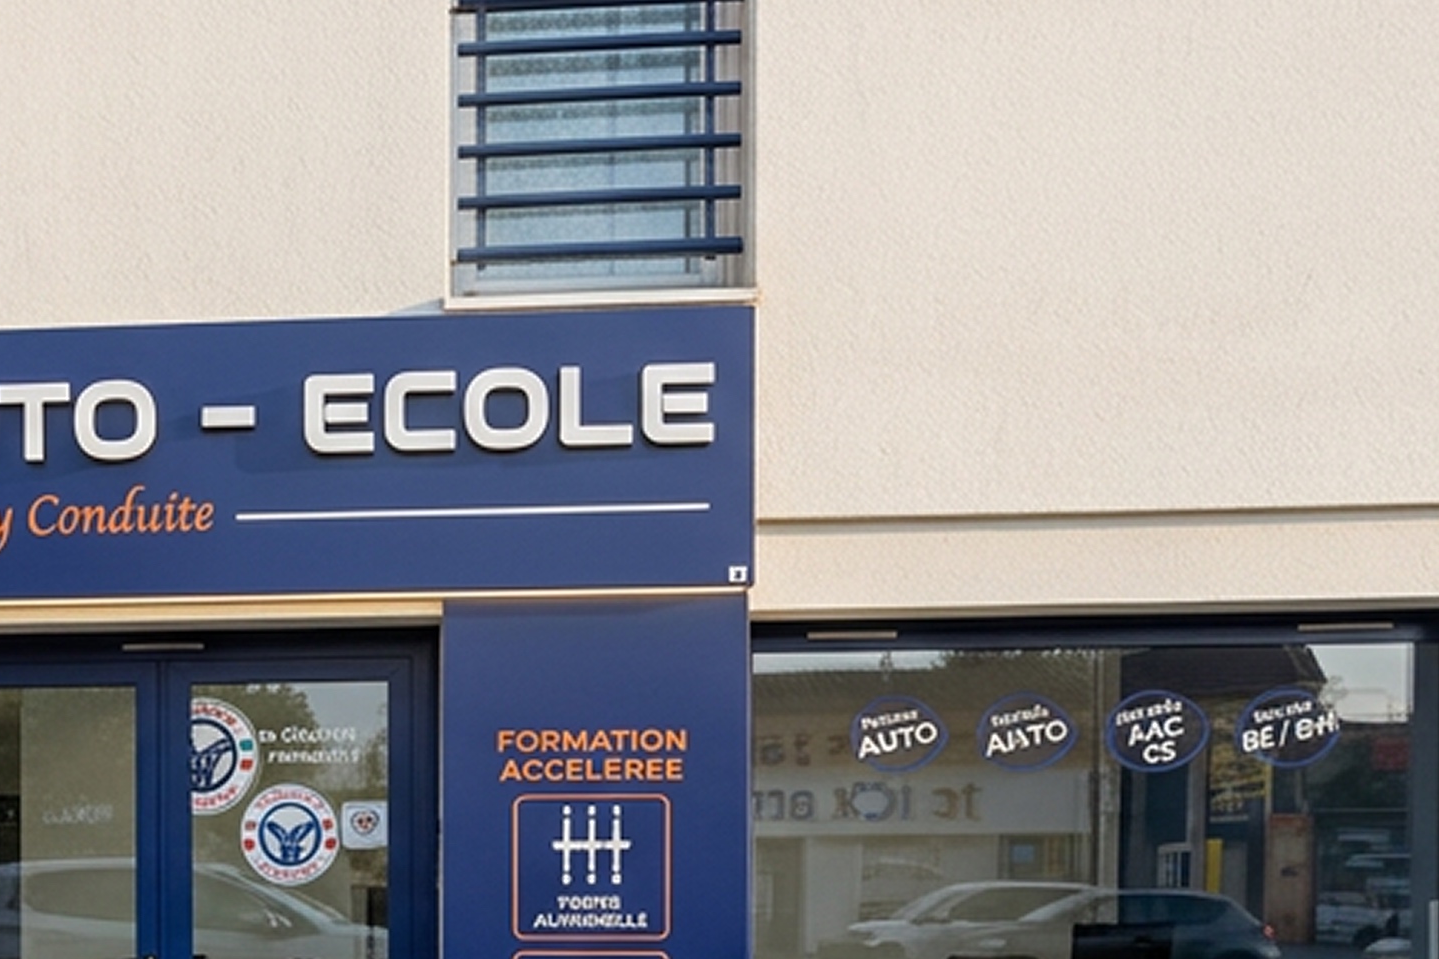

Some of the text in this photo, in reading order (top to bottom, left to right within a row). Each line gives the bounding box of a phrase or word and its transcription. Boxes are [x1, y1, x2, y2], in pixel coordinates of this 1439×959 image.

[302, 362, 716, 455] ECOLE
[27, 485, 215, 538] Conduite
[497, 729, 688, 754] FORMATION
[858, 721, 939, 760] AUTO
[1127, 714, 1185, 747] AAC
[1242, 725, 1275, 753] BE
[1142, 740, 1177, 764] CS
[499, 757, 684, 783] ACCELEREE
